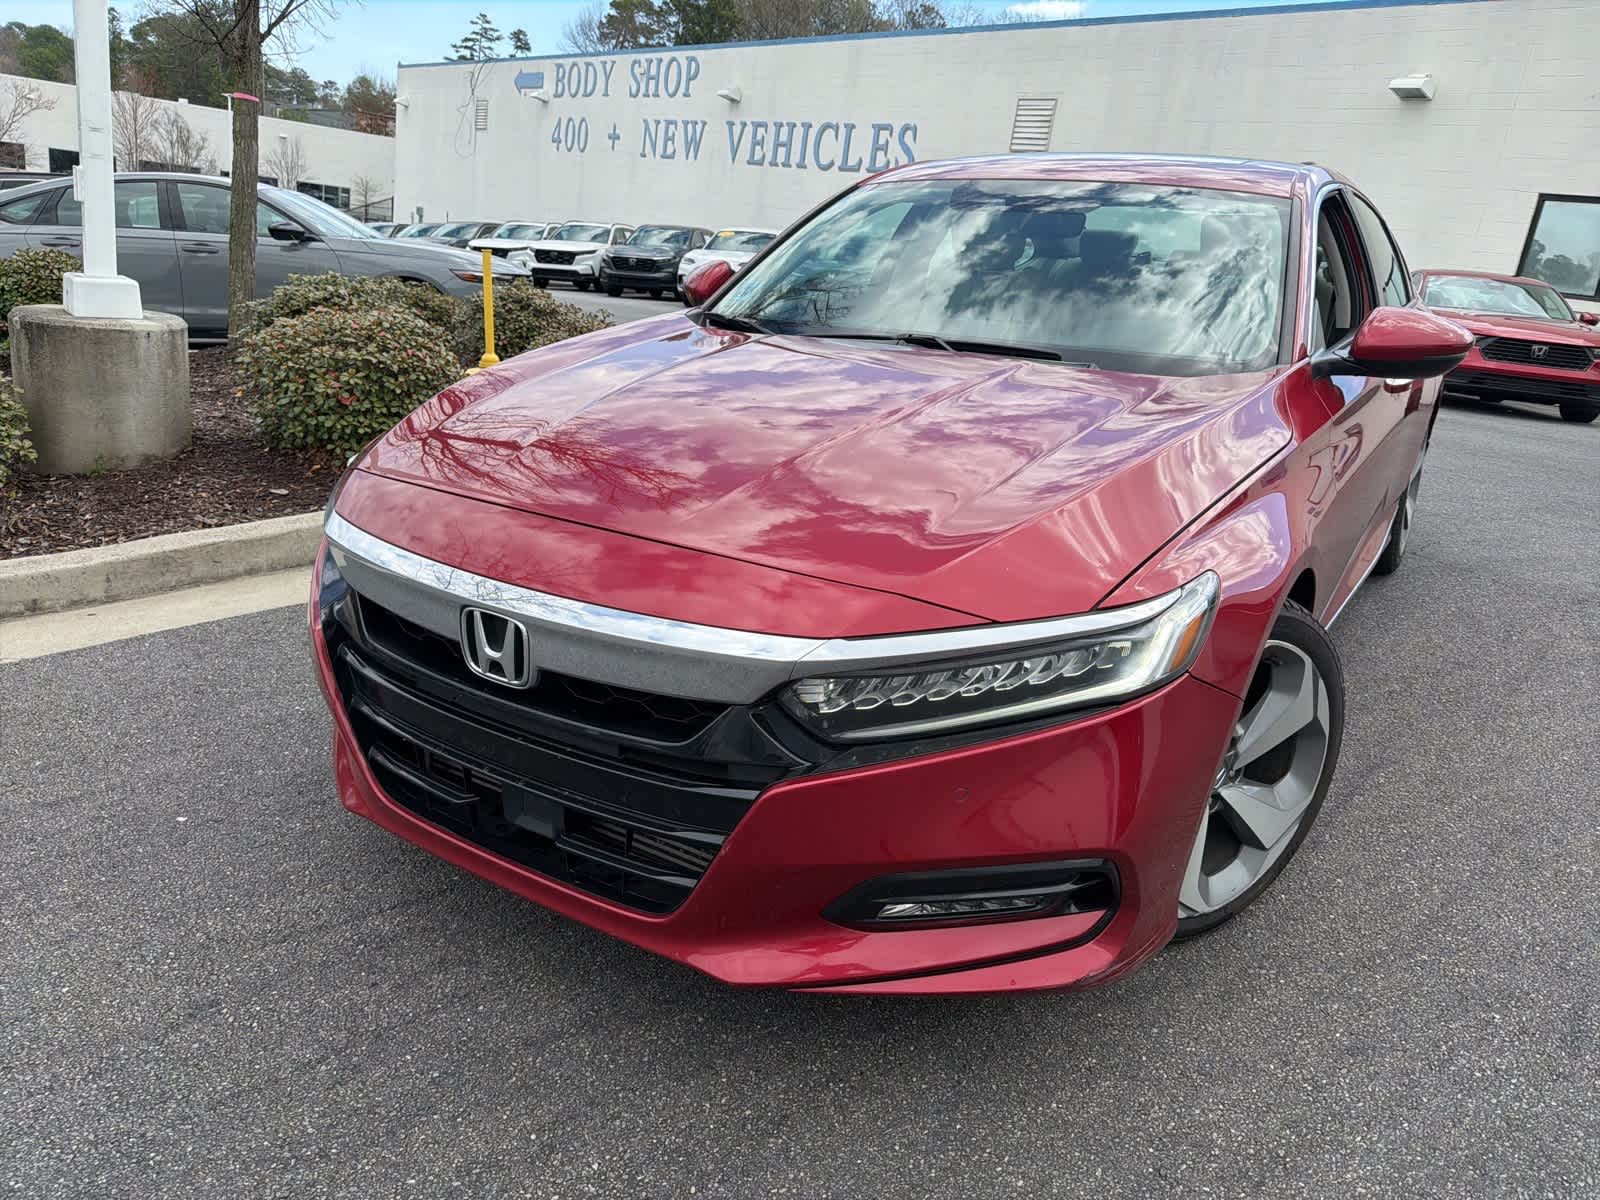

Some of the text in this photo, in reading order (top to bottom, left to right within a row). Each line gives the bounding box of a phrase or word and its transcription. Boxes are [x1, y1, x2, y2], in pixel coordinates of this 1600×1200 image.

[554, 56, 700, 98] BODY SHOP
[551, 117, 919, 173] 400 + NEW VEHICLES
